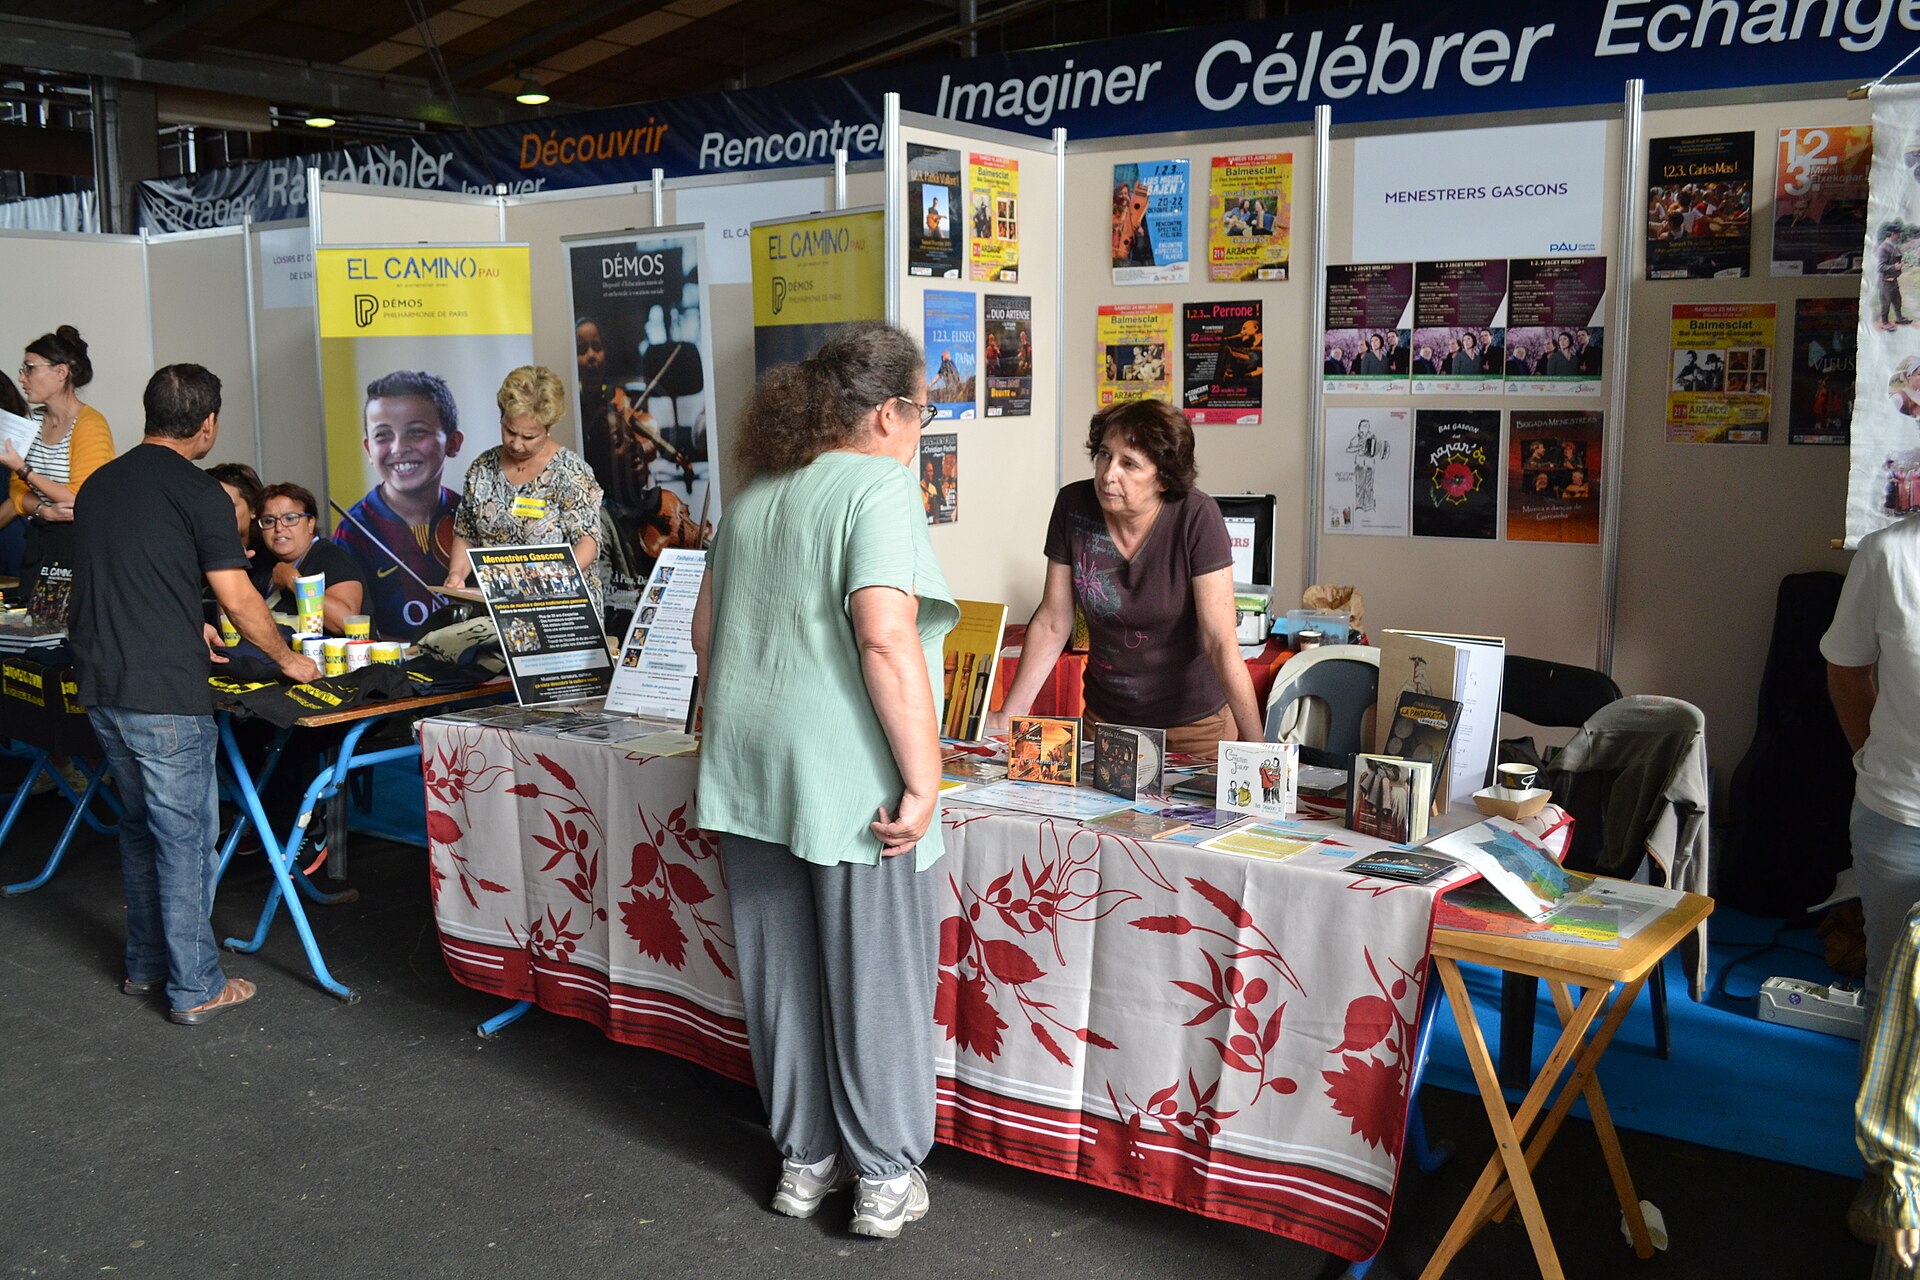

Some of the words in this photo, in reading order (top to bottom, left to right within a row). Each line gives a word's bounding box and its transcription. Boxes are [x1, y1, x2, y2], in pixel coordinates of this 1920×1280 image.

[1195, 22, 1555, 111] Célébrer
[936, 60, 1162, 126] Imaginer
[520, 117, 668, 170] Découvrir
[1226, 166, 1276, 177] Balmesclat
[461, 177, 546, 195] Innver
[1385, 187, 1486, 203] MENESTRERS
[1491, 183, 1568, 198] GASCONS
[723, 229, 735, 239] EL
[768, 235, 787, 260] EL
[347, 258, 378, 279] EL
[479, 268, 500, 278] PAU
[602, 252, 664, 278] DÉMOS
[383, 298, 423, 308] DÉMOS
[991, 309, 1004, 319] DUO
[1213, 305, 1253, 318] Perrone
[1111, 315, 1158, 324] Balmesclat
[1689, 320, 1752, 329] Balmesclat
[528, 552, 565, 561] Gascons
